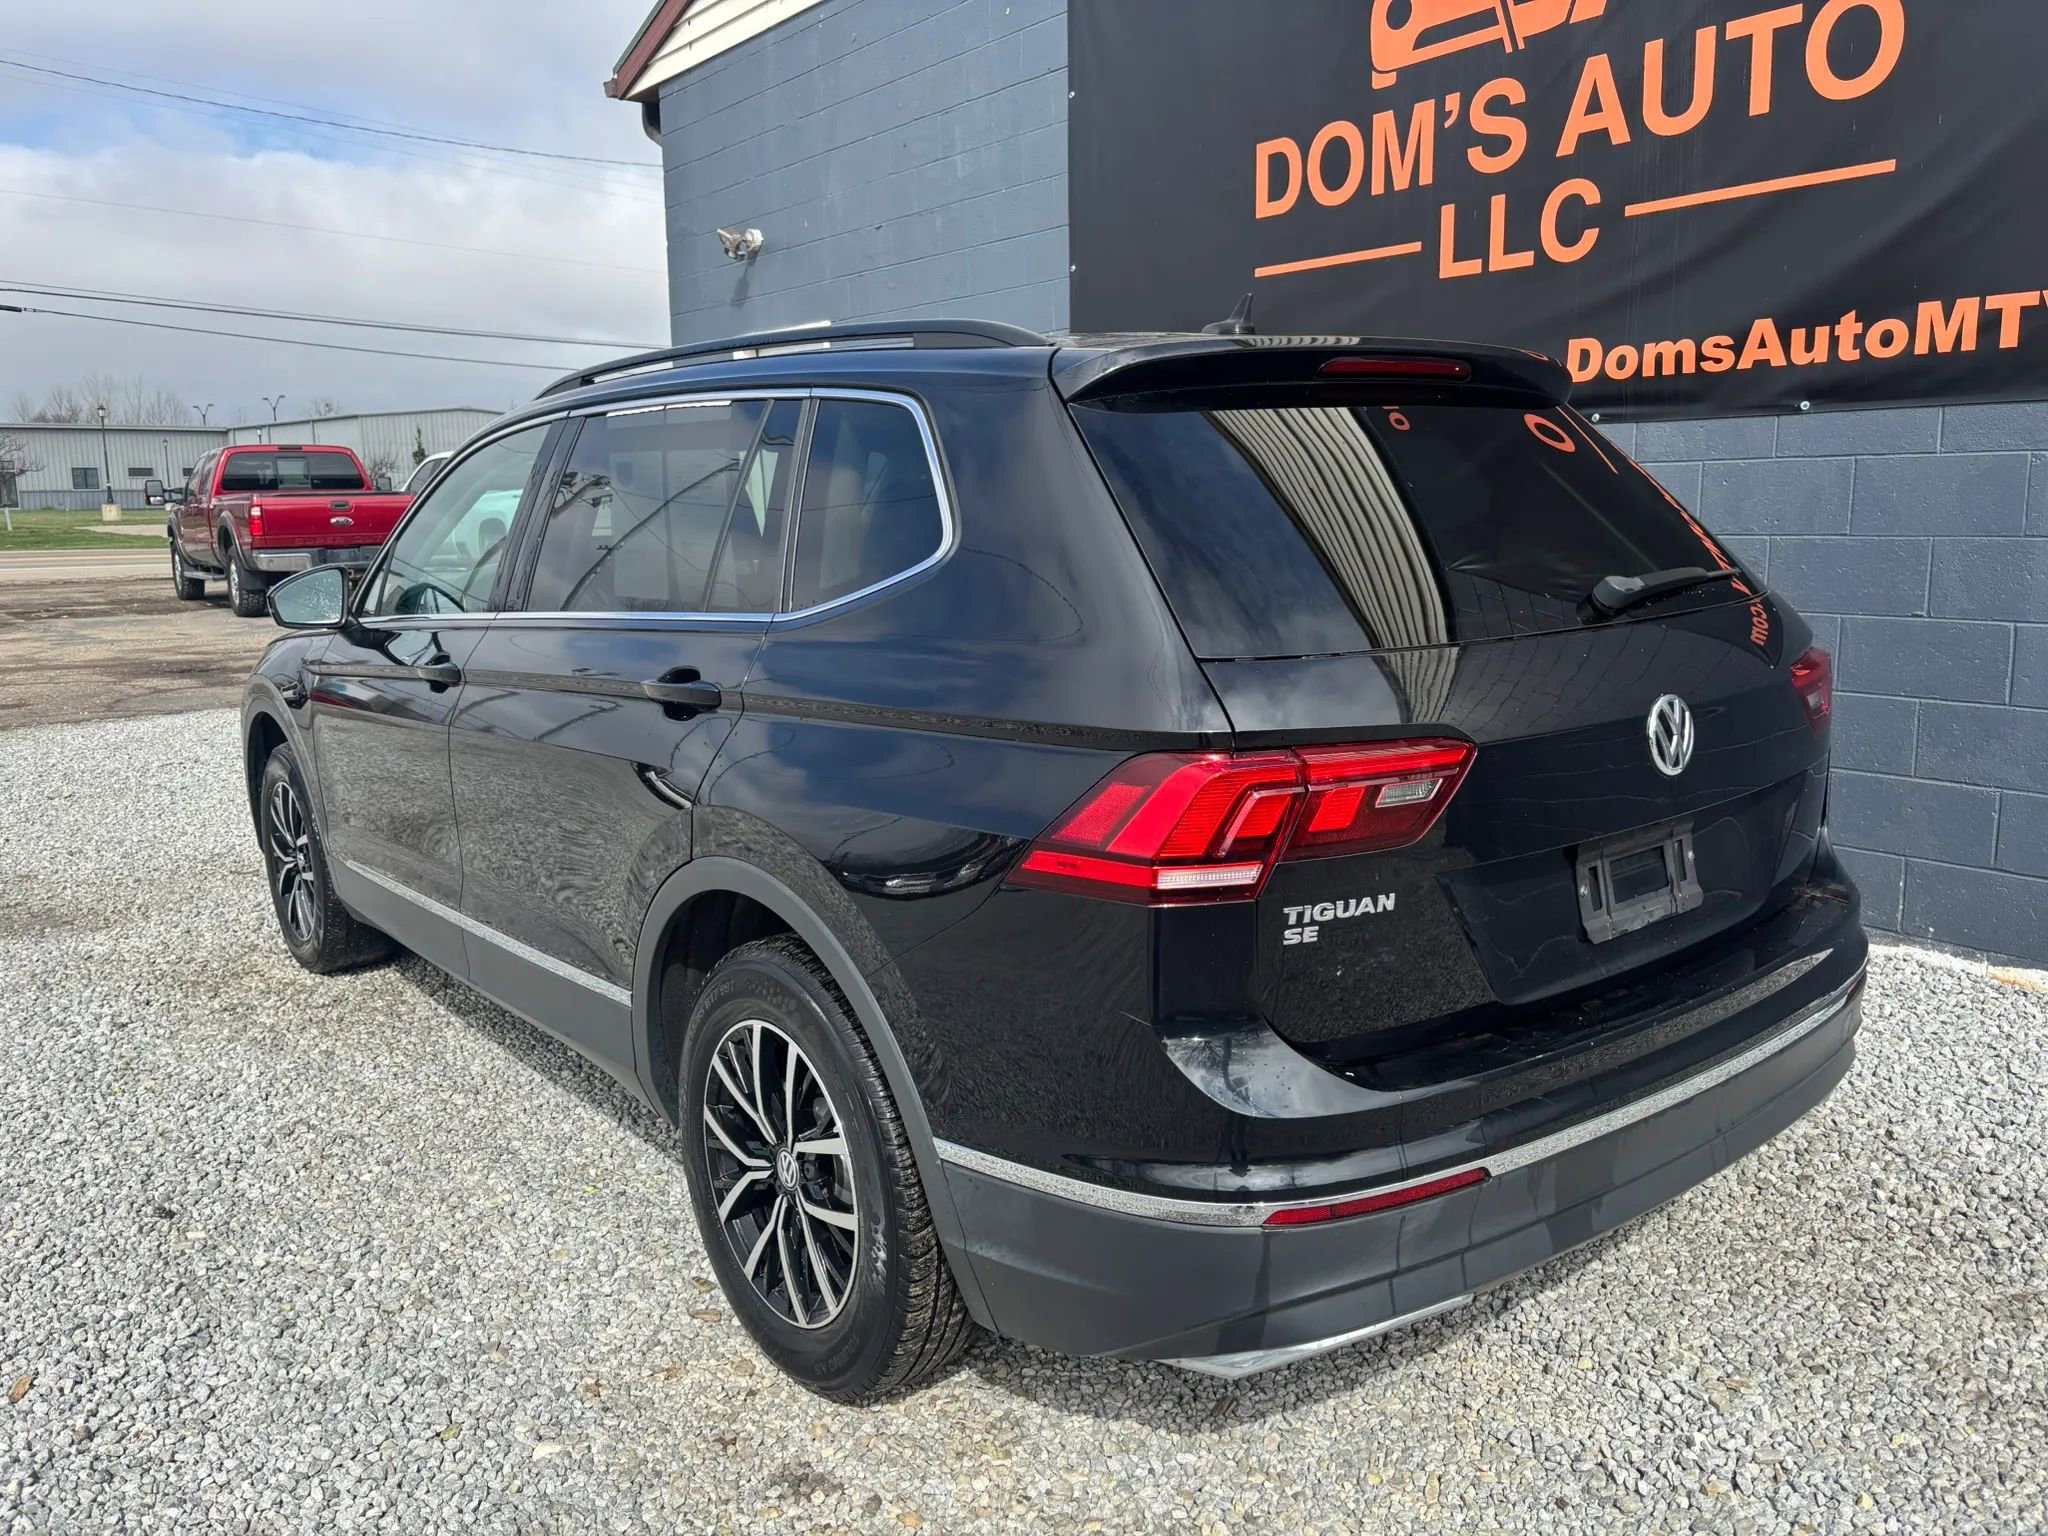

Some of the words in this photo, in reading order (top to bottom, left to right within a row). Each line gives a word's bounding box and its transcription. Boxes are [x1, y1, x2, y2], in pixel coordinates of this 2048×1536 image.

[1256, 78, 1528, 219] DOM'S
[1556, 0, 1905, 157] AUTO
[1439, 179, 1601, 279] LLC
[1567, 288, 2048, 383] DomsAutoMT
[1282, 892, 1396, 925] TIGUAN
[1282, 926, 1319, 946] SE
